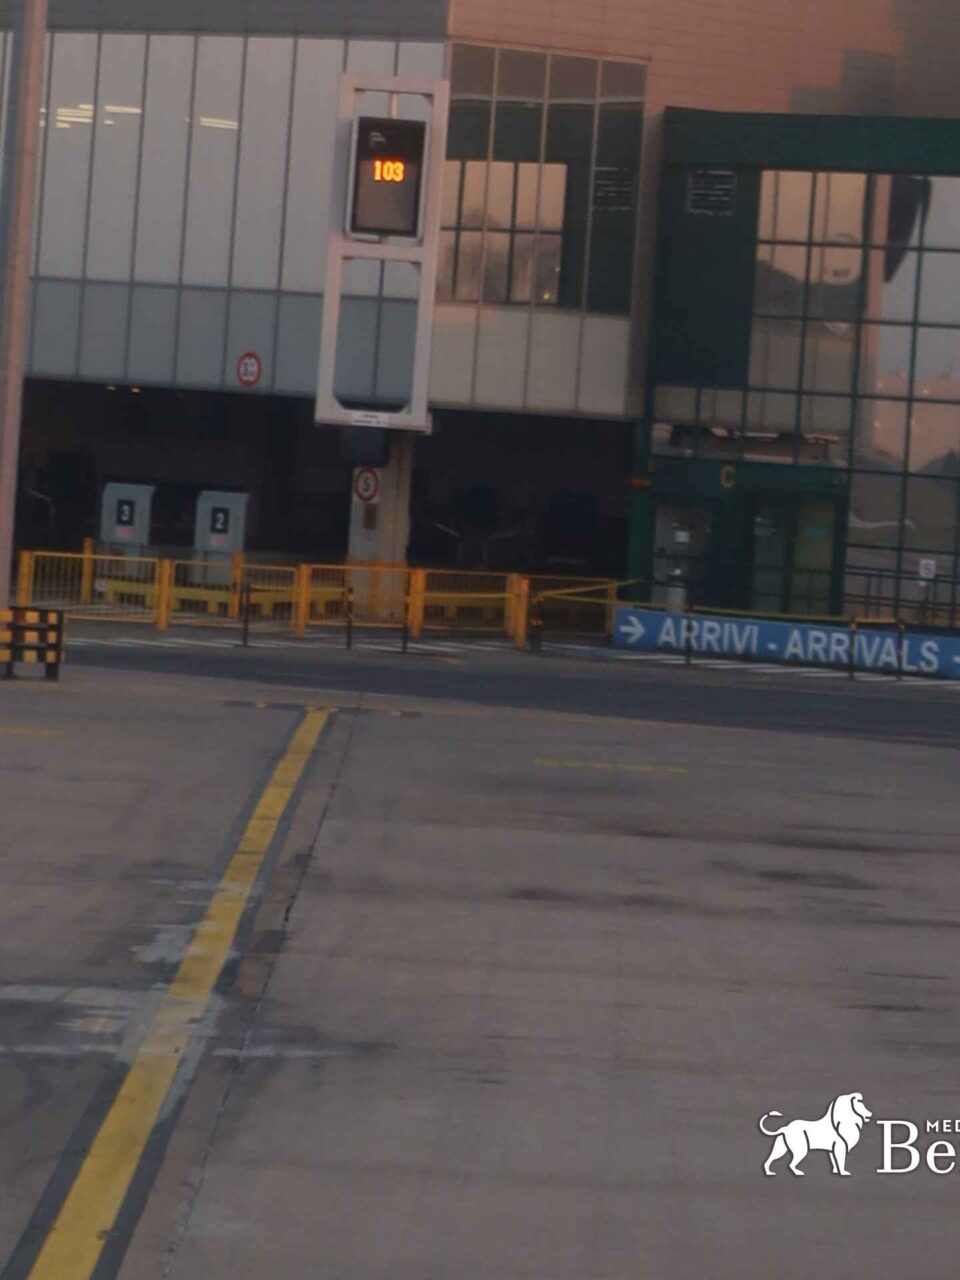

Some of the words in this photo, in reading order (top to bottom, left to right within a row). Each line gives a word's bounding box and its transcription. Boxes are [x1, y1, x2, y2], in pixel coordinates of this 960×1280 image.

[373, 160, 405, 182] 103
[719, 465, 735, 488] C
[656, 617, 759, 654] ARRIVI
[784, 631, 940, 673] ARRIVALS
